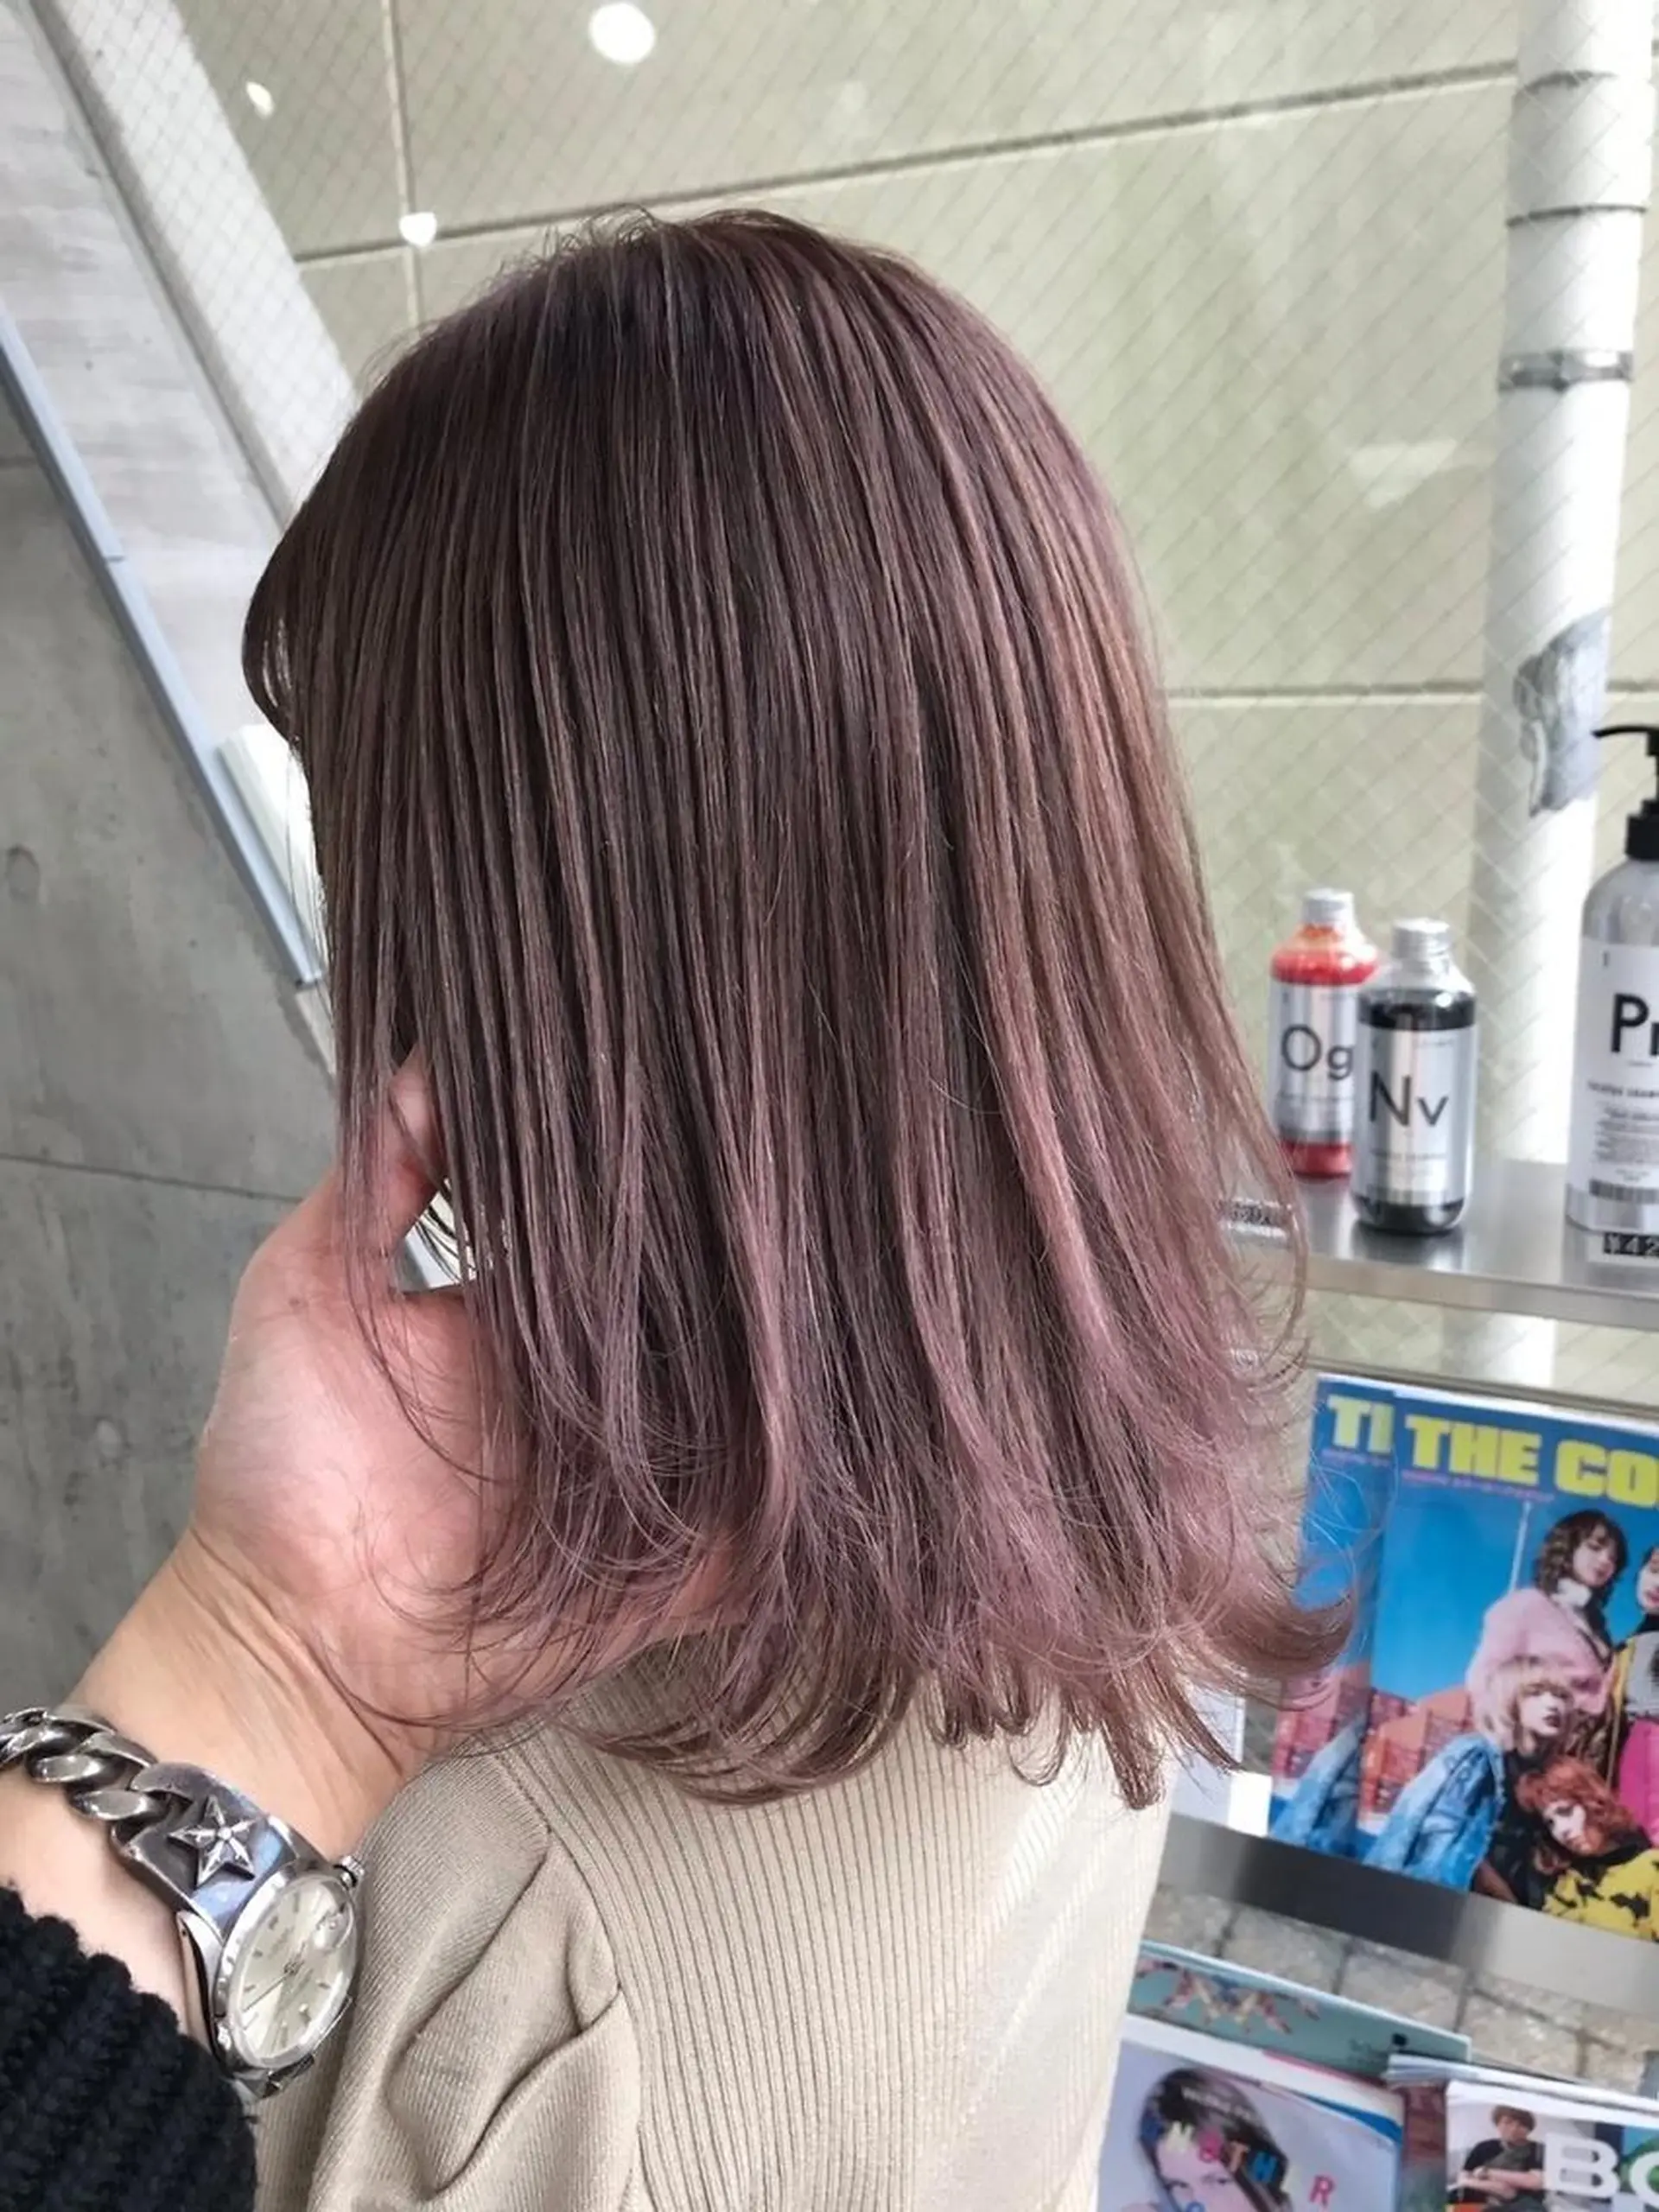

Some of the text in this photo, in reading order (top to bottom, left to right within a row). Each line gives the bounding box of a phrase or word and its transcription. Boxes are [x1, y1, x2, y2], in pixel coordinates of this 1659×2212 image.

[1281, 1024, 1354, 1080] Og
[1369, 1070, 1449, 1128] Nv
[1404, 1414, 1542, 1487] THE
